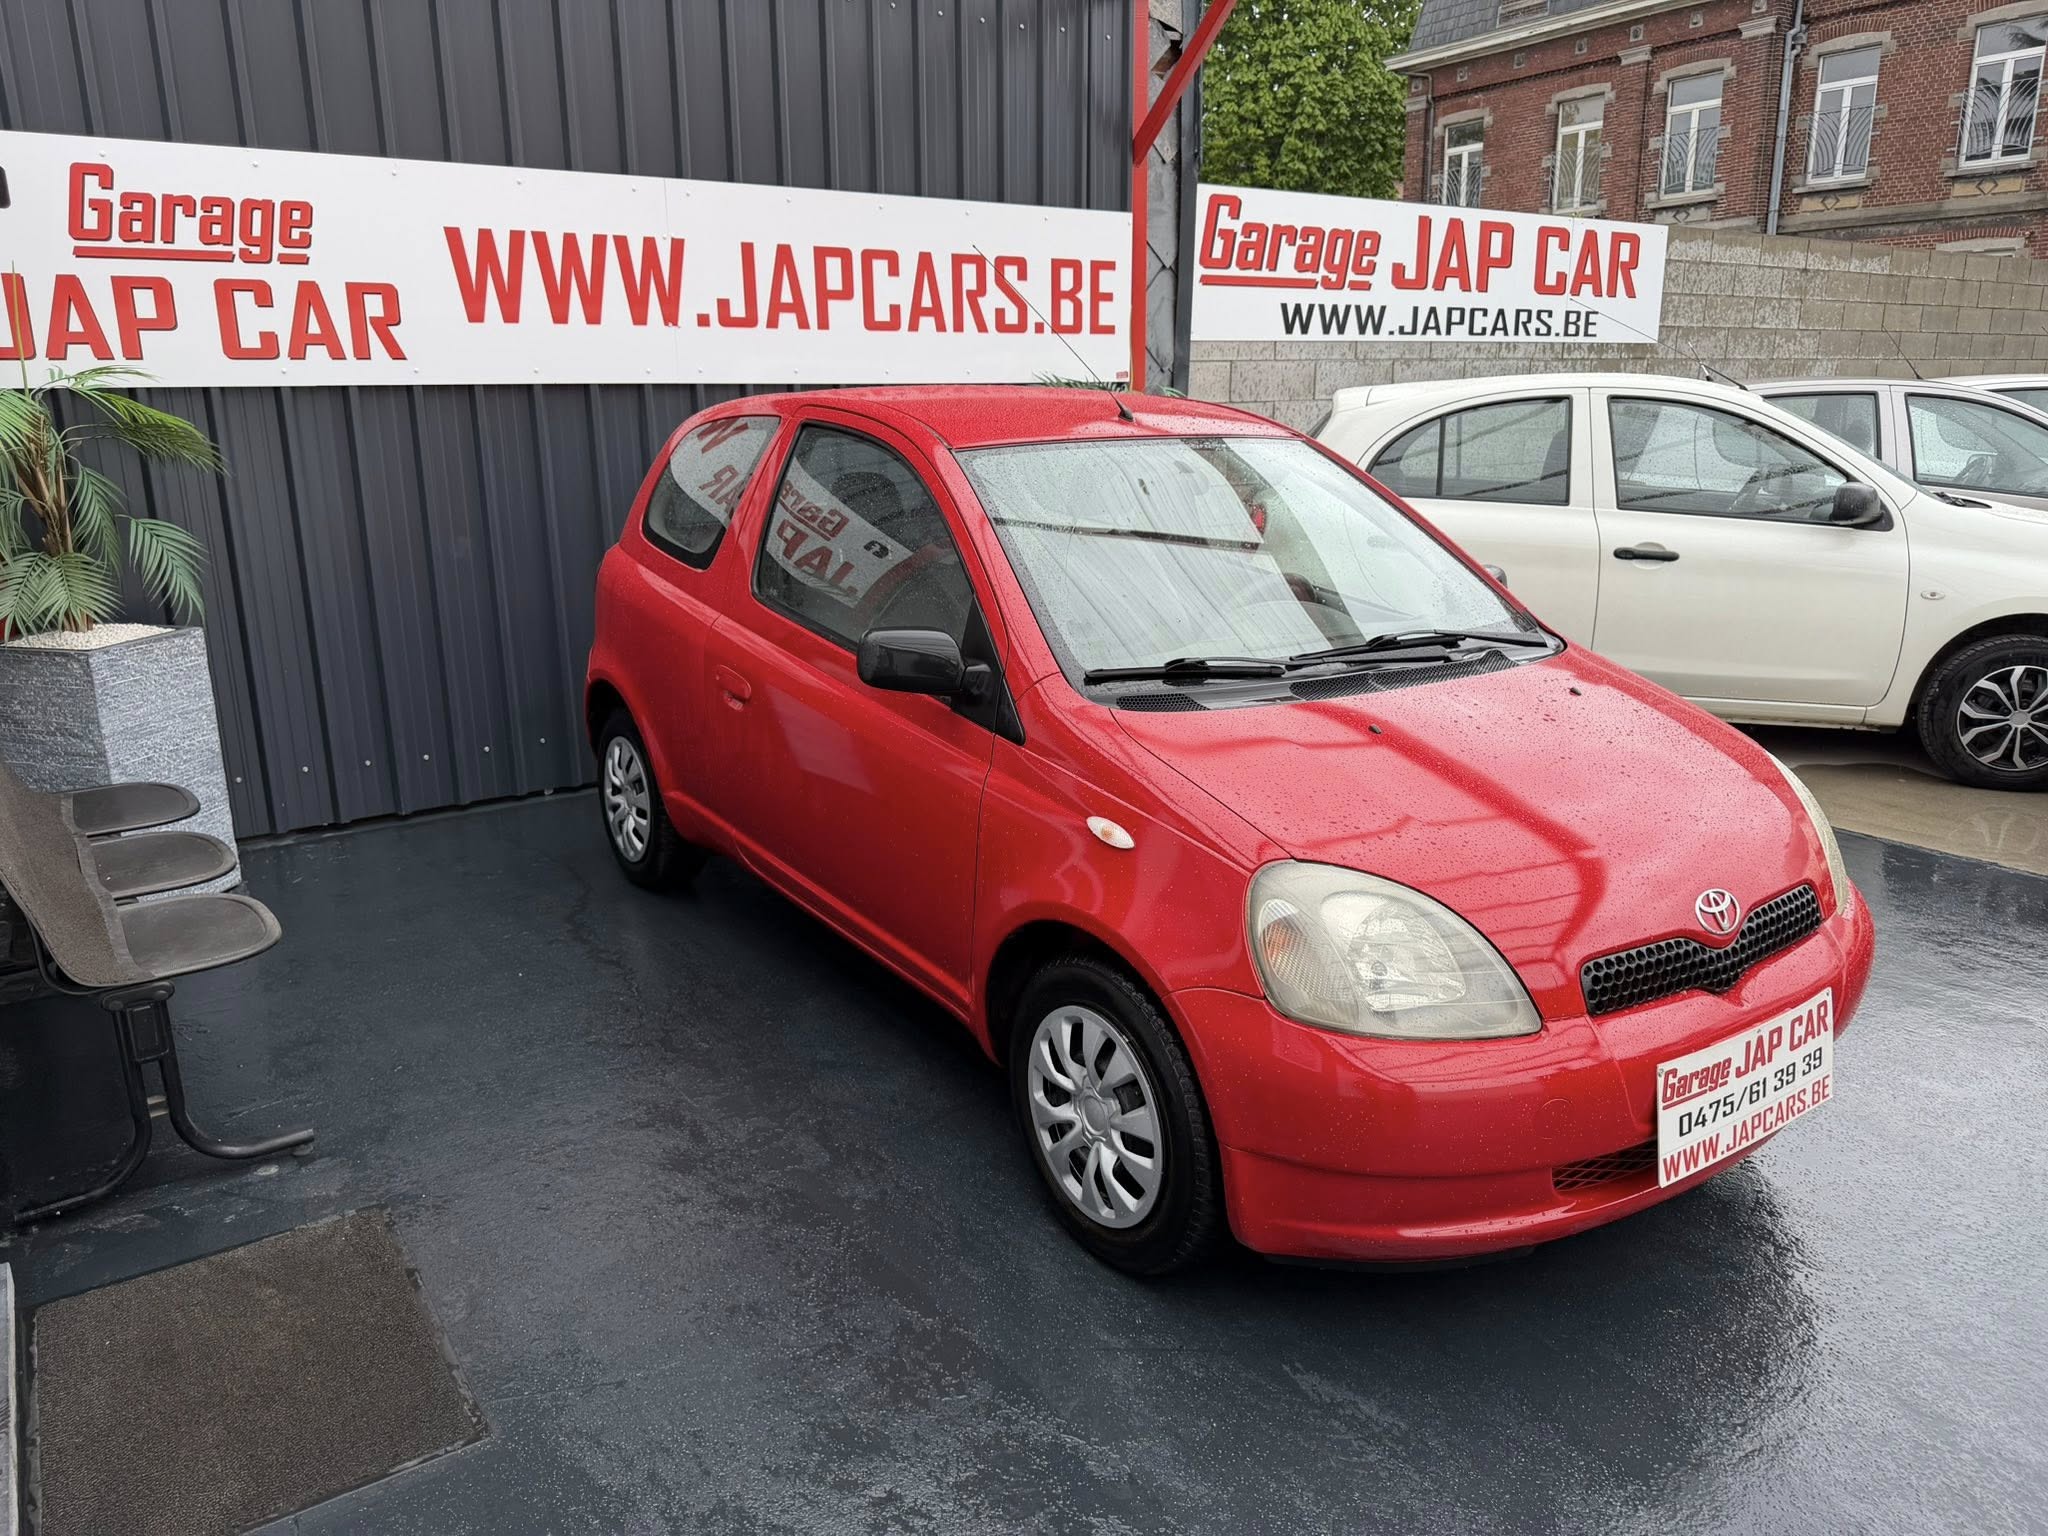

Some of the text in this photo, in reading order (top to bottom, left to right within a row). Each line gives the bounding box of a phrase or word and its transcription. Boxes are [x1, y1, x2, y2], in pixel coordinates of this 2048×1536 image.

[68, 162, 313, 264] Garage
[1199, 193, 1641, 299] Garage JAP CAR
[0, 272, 408, 360] JAP CAR
[443, 226, 1116, 335] WWW.JAPCARS.BE
[1280, 302, 1599, 338] WWW.JAPCARS.BE
[1662, 999, 1829, 1110] Garage JAP CAR
[1679, 1046, 1823, 1138] 0475/61 39 39
[1662, 1074, 1830, 1182] WWW.JAPCARS.BE
